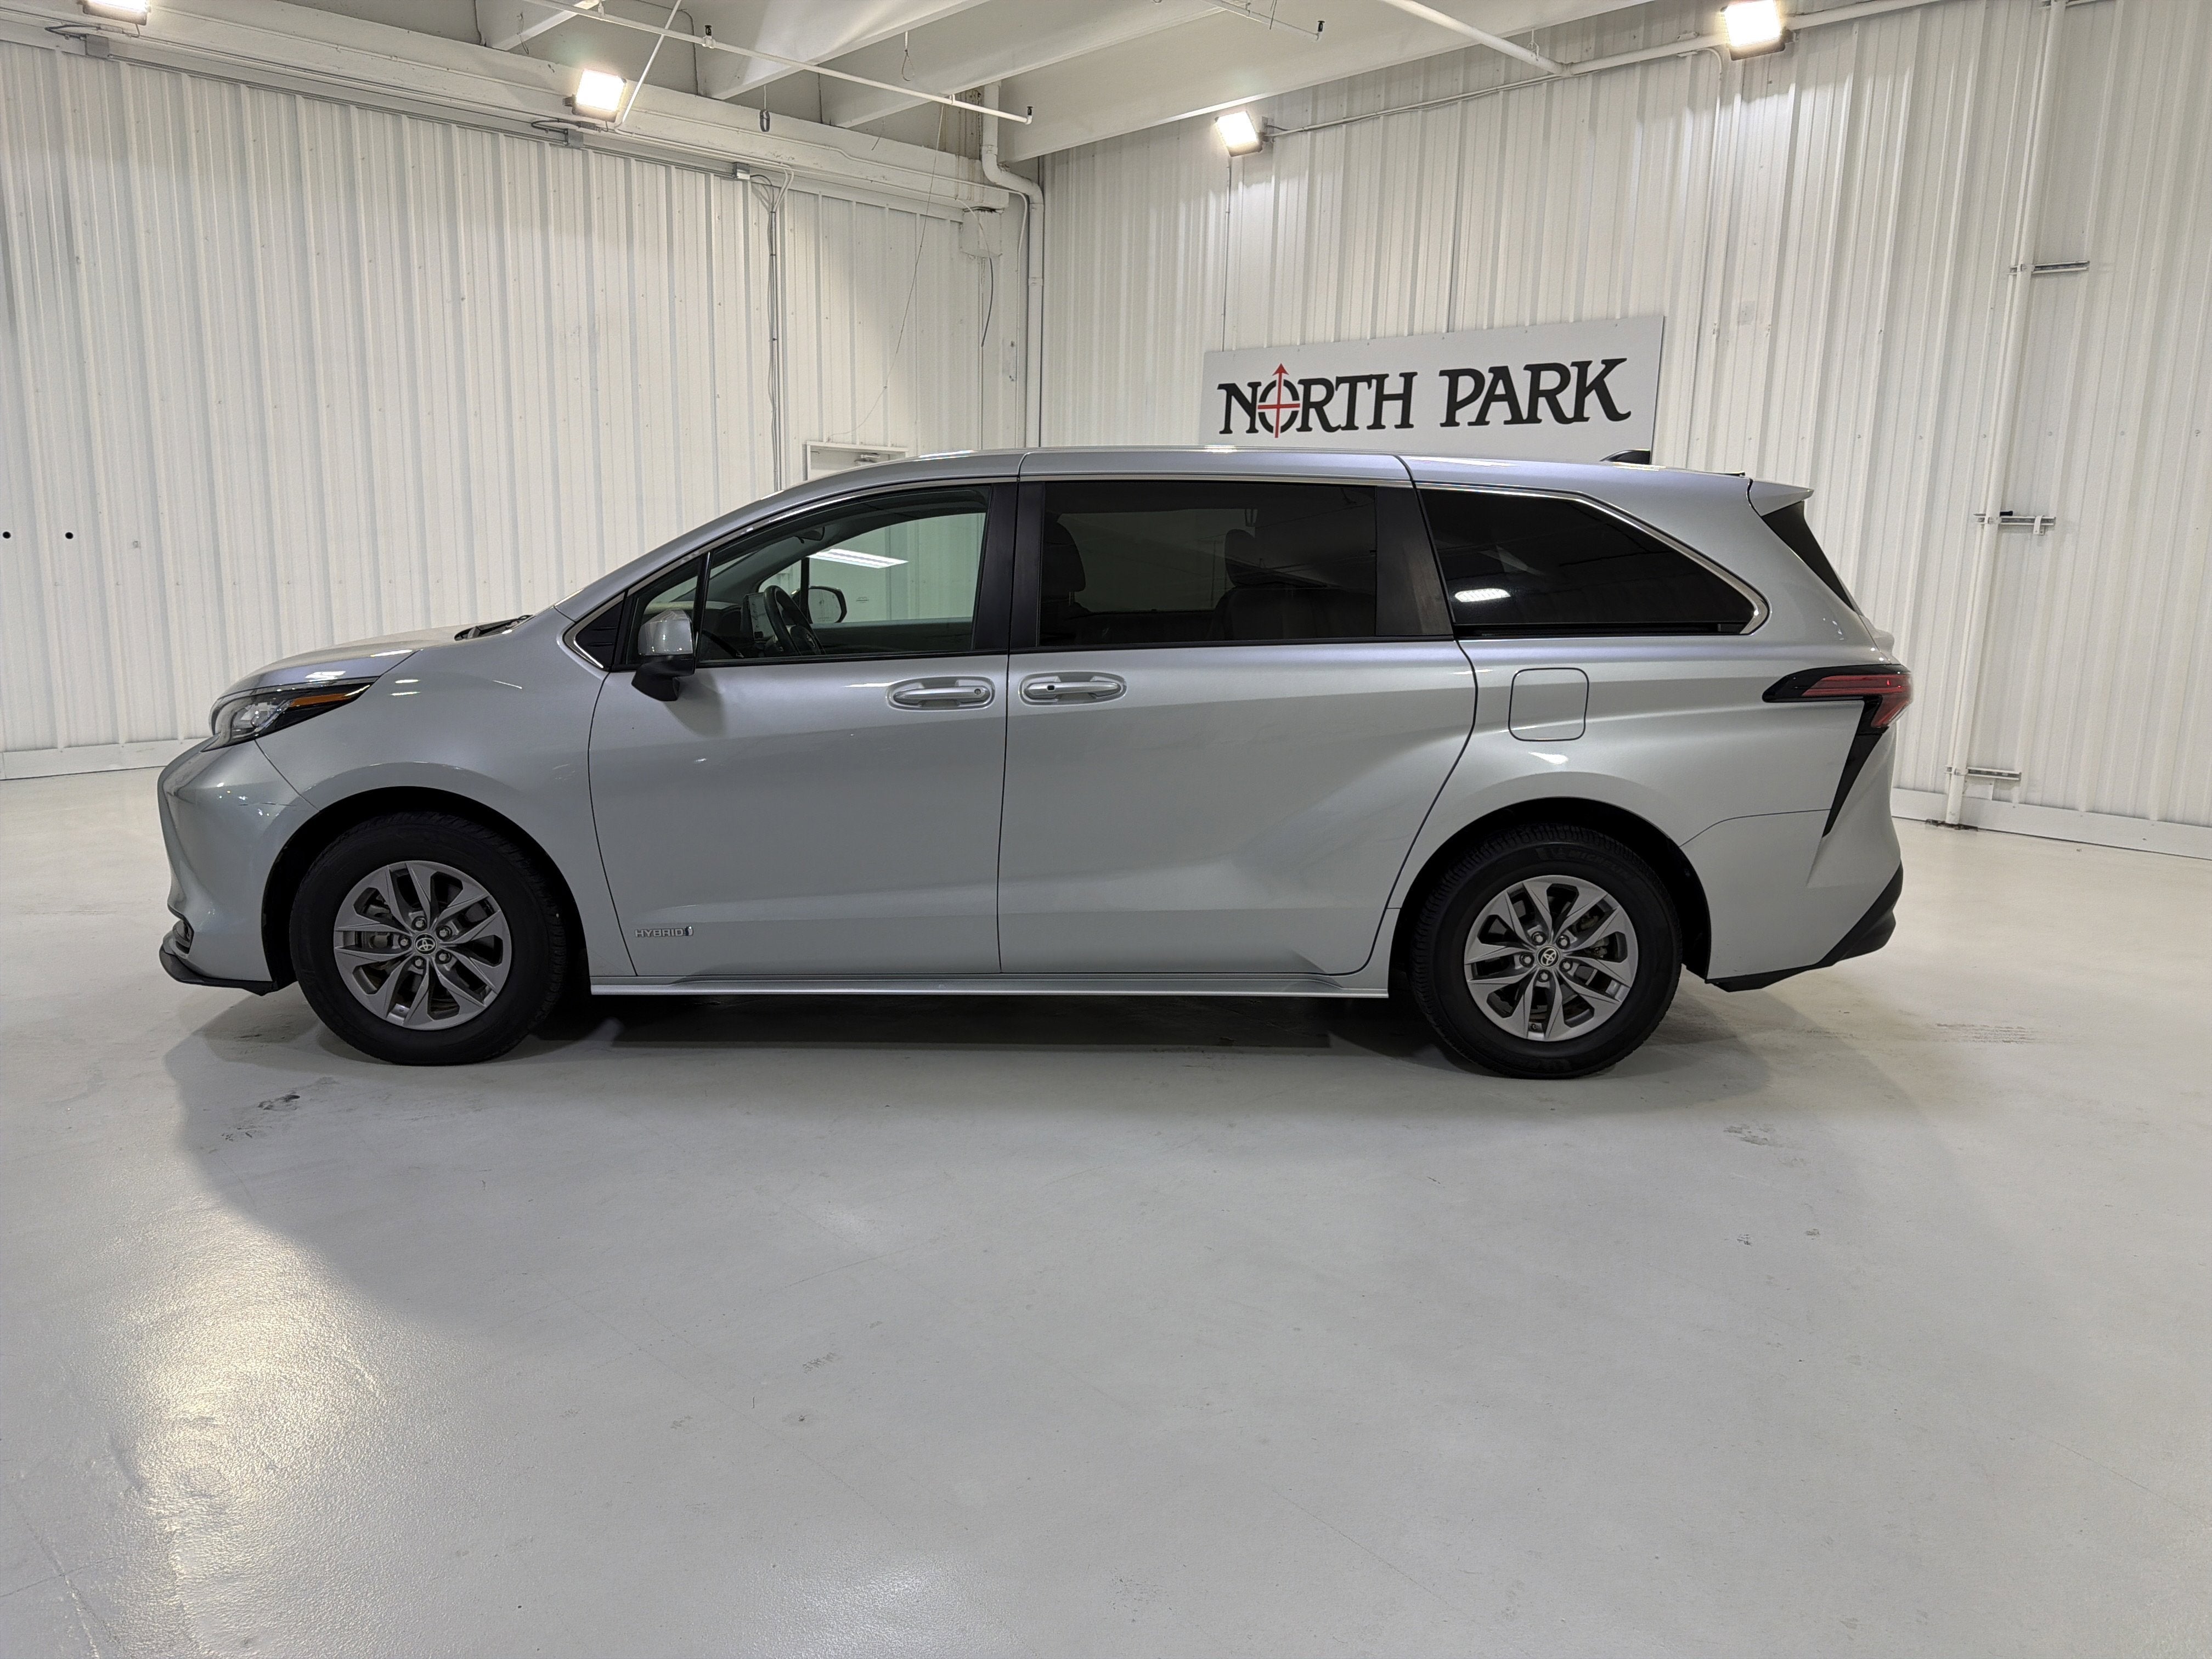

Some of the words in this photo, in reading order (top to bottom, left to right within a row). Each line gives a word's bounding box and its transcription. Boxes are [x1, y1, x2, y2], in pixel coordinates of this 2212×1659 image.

[1217, 371, 1418, 435] NORTH
[1438, 358, 1632, 427] PARK
[635, 928, 684, 938] HYBRID
